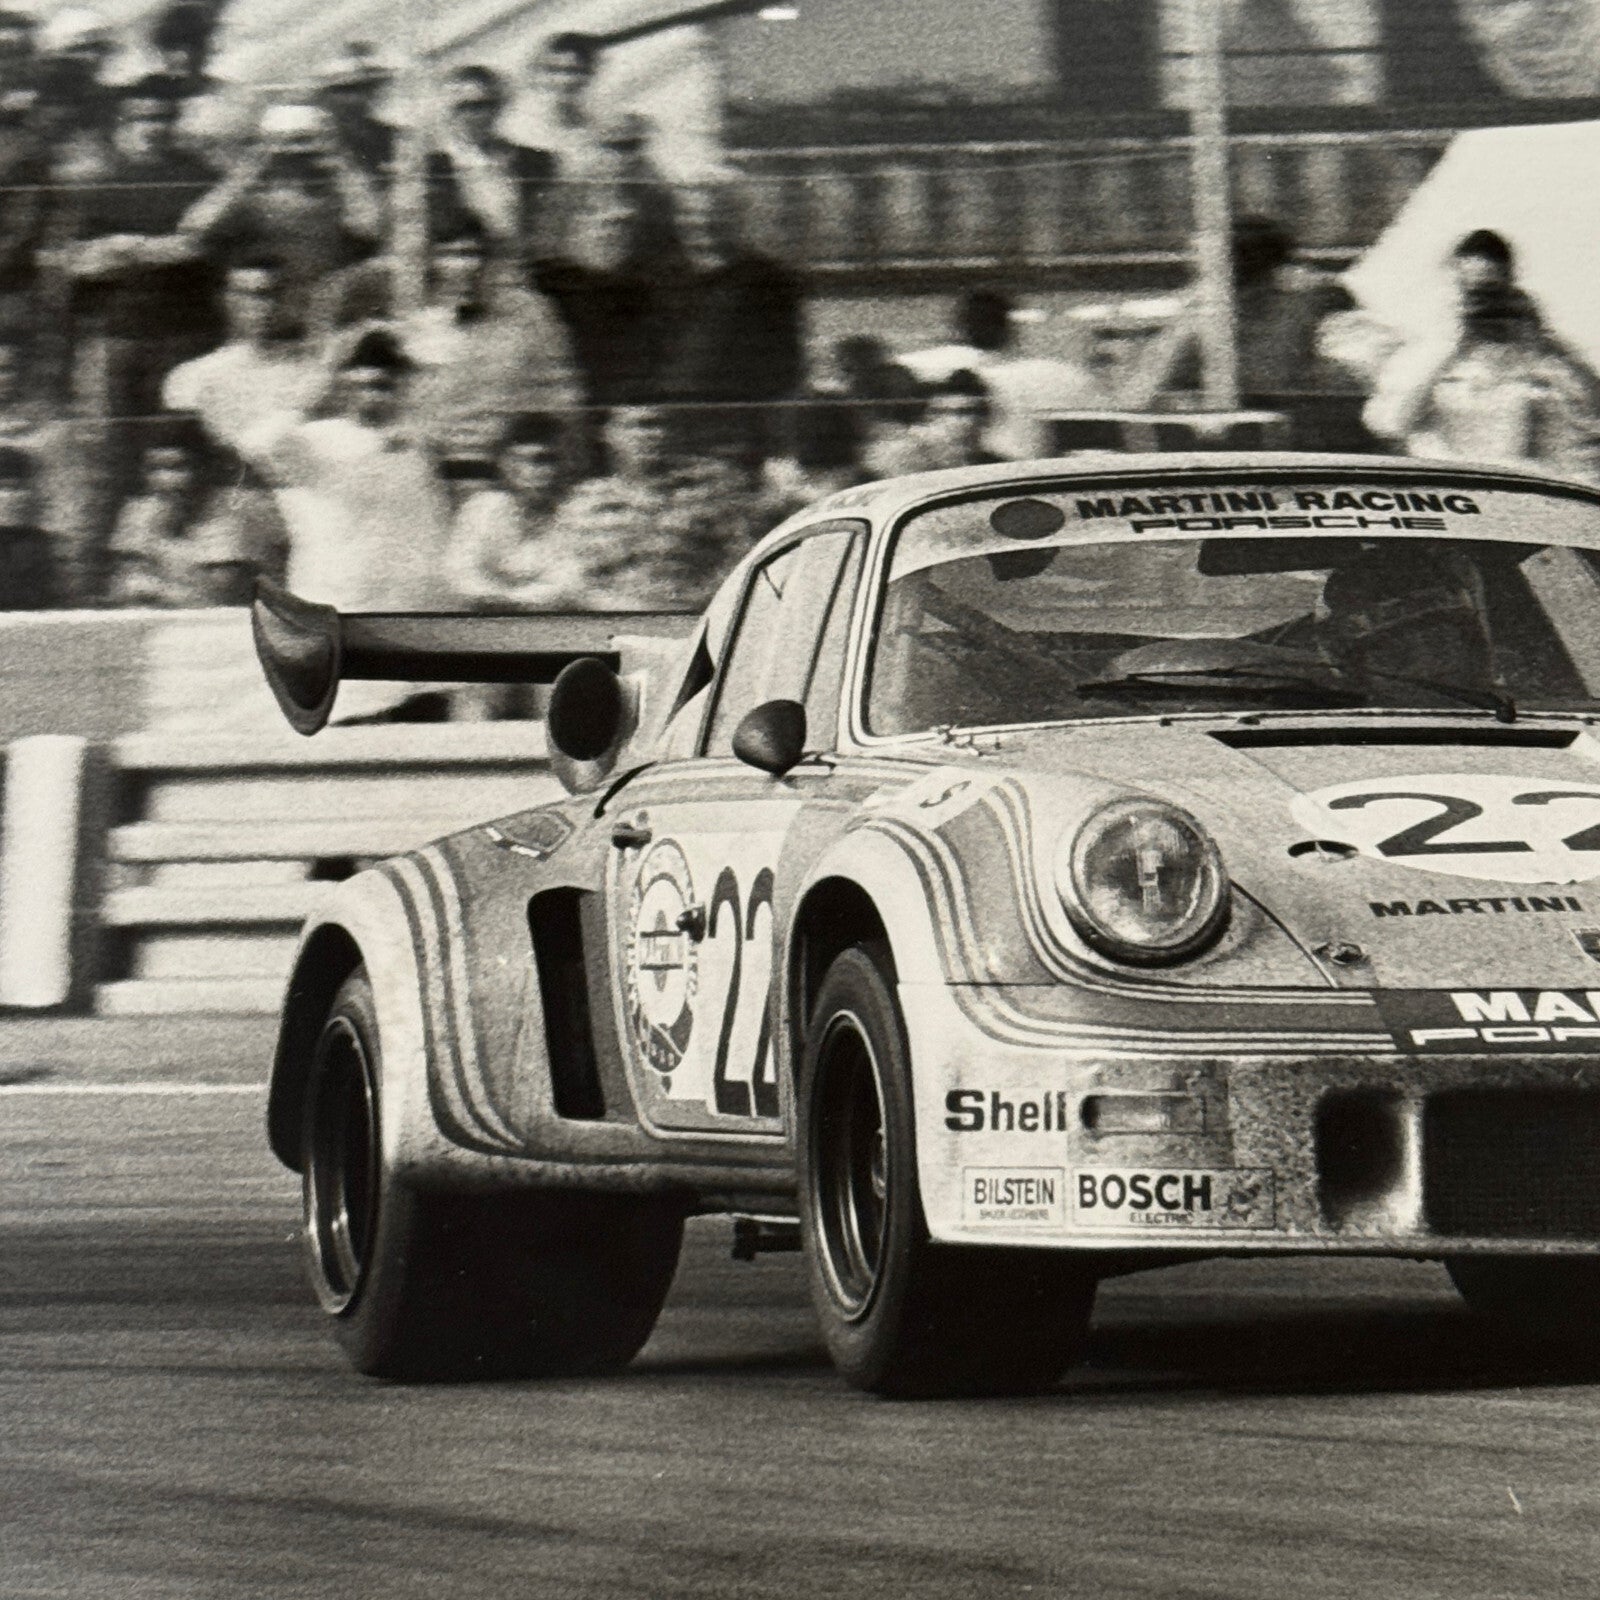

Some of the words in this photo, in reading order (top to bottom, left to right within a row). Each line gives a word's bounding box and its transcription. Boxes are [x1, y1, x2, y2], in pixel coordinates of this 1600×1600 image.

[1076, 491, 1278, 519] MARTINI
[1294, 491, 1480, 515] RACING
[1131, 515, 1447, 533] PORSCHE
[1369, 897, 1583, 917] MARTINI
[1450, 991, 1600, 1023] MA
[945, 1089, 1067, 1132] Shell
[974, 1177, 1055, 1205] BILSTEIN
[1078, 1174, 1211, 1210] BOSCH
